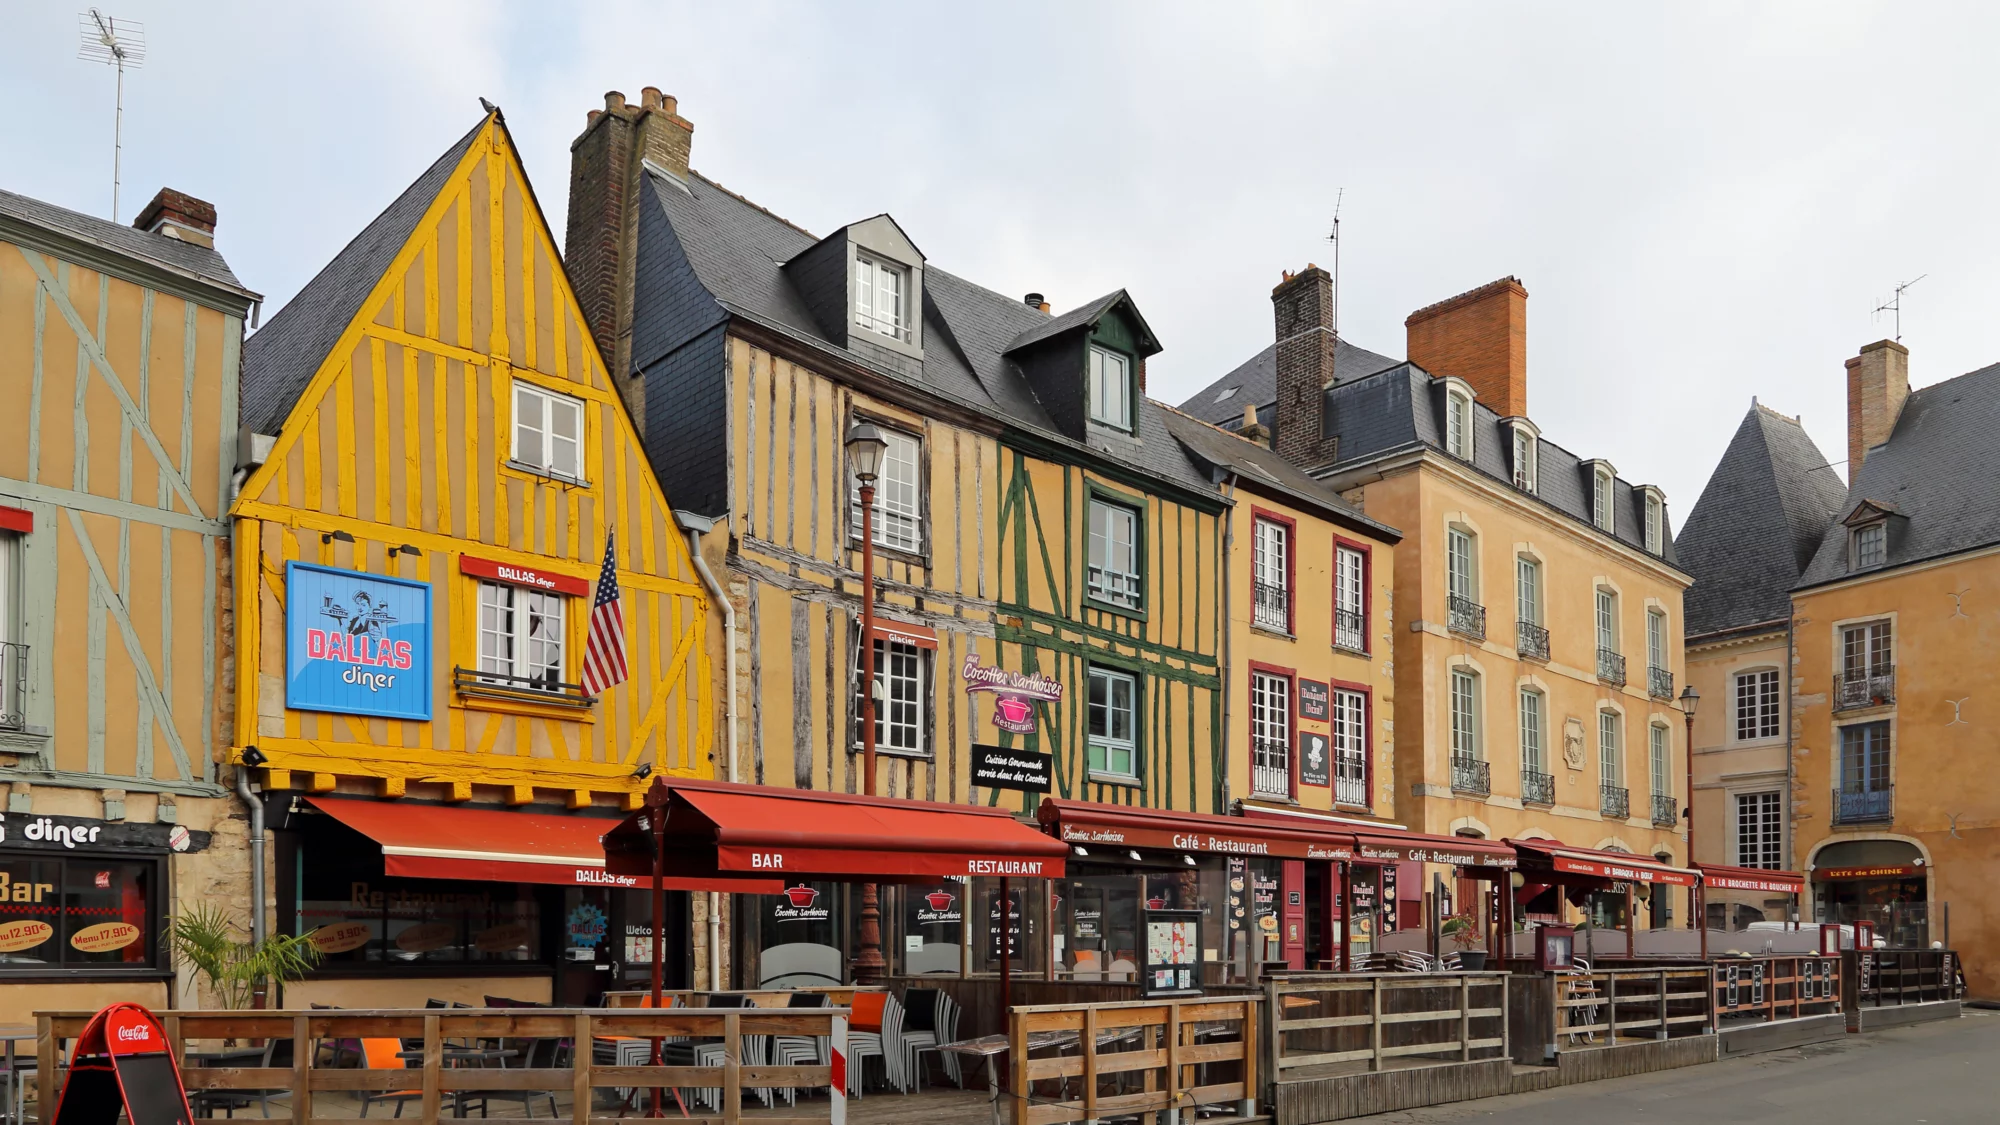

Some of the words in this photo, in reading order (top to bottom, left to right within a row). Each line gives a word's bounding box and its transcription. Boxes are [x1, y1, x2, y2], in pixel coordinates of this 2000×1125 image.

[498, 566, 535, 584] DALLAS
[536, 578, 556, 589] diner
[888, 633, 917, 646] Glacier
[306, 628, 413, 671] DALLAS
[966, 655, 979, 664] aux
[342, 665, 396, 693] diner
[963, 662, 1008, 686] Cocottes
[1010, 671, 1063, 697] Sarthoises
[994, 714, 1035, 731] Restaurant
[985, 753, 1008, 767] Cuisine
[977, 768, 997, 779] servie
[24, 817, 101, 849] diner
[1063, 829, 1090, 841] Cocottes
[1091, 829, 1125, 843] Sarthoises
[1173, 833, 1199, 850] Café
[1209, 836, 1268, 855] Restaurant
[752, 853, 783, 869] BAR
[968, 860, 1043, 875] RESTAURANT
[1409, 849, 1427, 863] Café
[1433, 853, 1475, 866] Restaurant
[576, 869, 615, 884] DALLAS
[616, 875, 637, 887] diner
[1604, 866, 1611, 875] LA
[1612, 867, 1635, 878] BARAQUE
[1869, 867, 1903, 875] CHINE
[1718, 878, 1726, 887] LA
[1728, 879, 1759, 889] BROCHETTE
[1769, 882, 1792, 893] BOUCHER
[775, 908, 798, 917] Cocottes
[799, 906, 829, 917] Sarthoises
[74, 934, 99, 945] Menu
[99, 925, 134, 940] 17.90€
[336, 925, 368, 941] 9.90€
[626, 925, 666, 935] Welcoe
